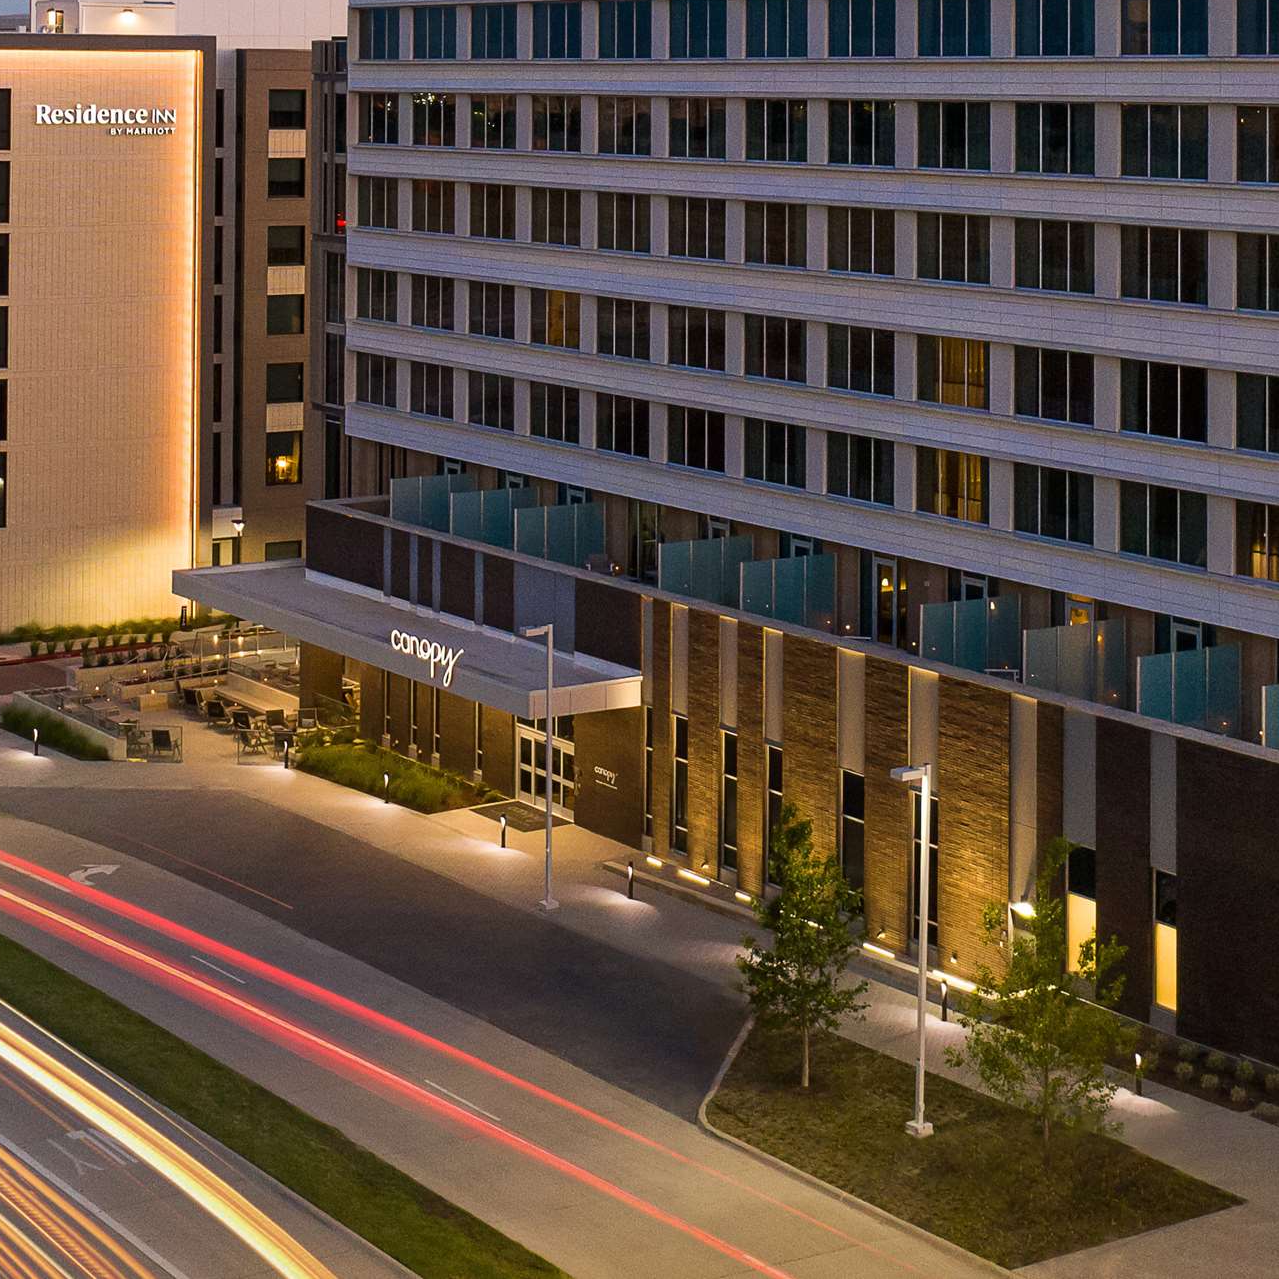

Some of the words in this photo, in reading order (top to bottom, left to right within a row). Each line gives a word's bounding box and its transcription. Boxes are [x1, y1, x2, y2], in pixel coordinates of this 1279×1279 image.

[35, 103, 149, 124] Residence
[151, 108, 177, 124] INN
[110, 127, 122, 135] BY
[126, 127, 176, 135] MARRIOTT
[390, 629, 464, 688] canopy
